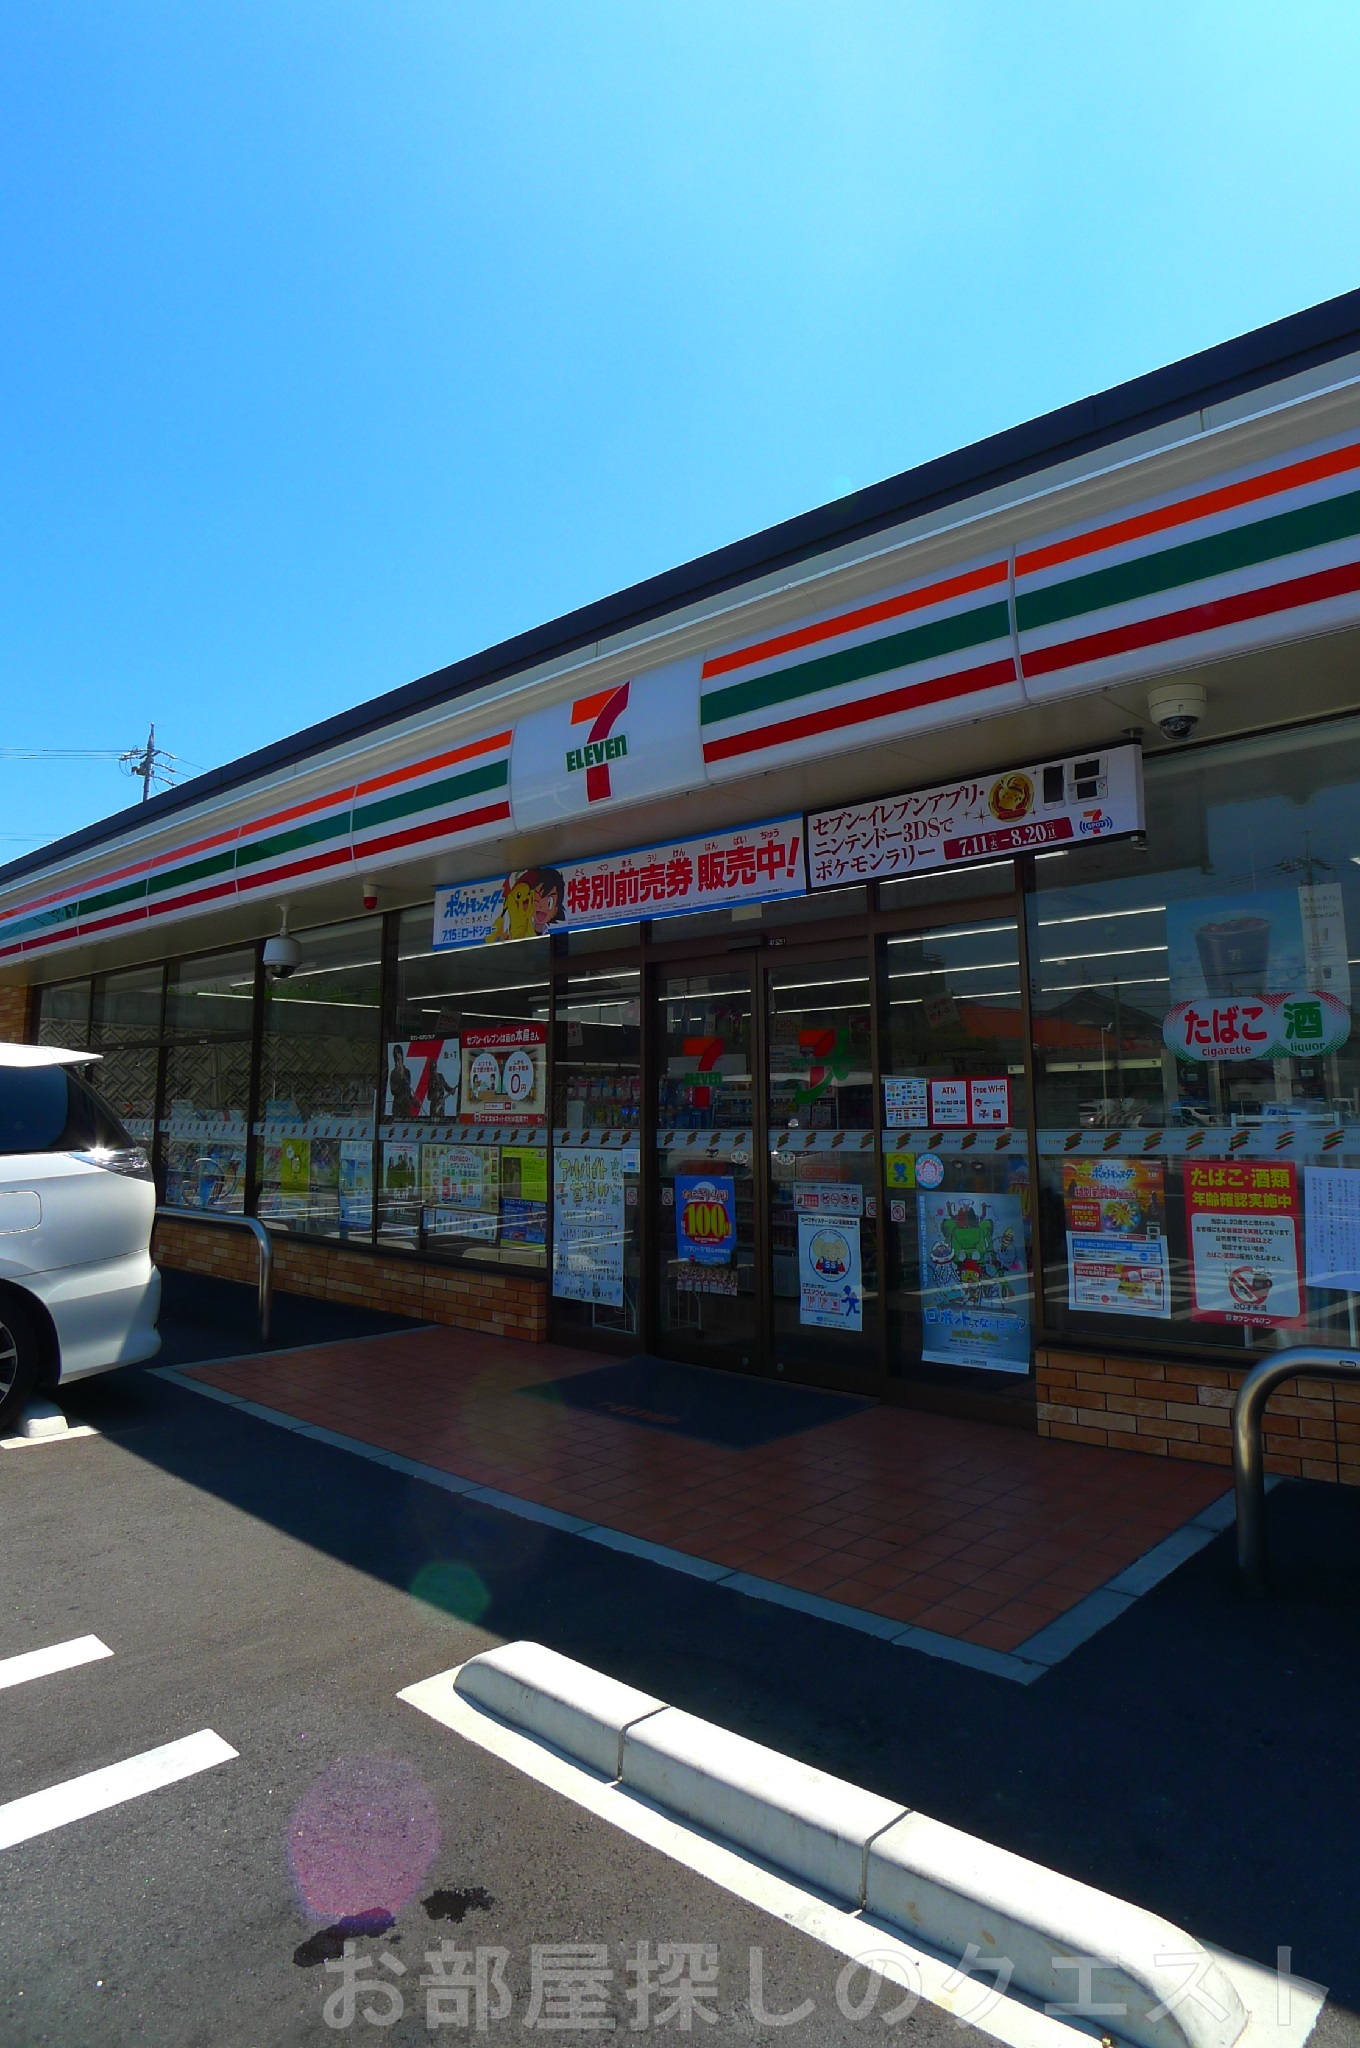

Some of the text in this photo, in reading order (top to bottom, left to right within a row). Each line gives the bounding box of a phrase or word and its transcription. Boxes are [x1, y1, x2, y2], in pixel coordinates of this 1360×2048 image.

[570, 681, 630, 802] 7
[814, 817, 955, 858] ニンテンドー3DSで
[815, 847, 936, 881] ポケモンラリー
[567, 857, 694, 914] 特別前売券
[443, 889, 505, 918] ポケットモンスター
[1184, 1004, 1268, 1046] たばこ
[1283, 1000, 1324, 1040] 酒
[1201, 1045, 1252, 1058] cigarette
[1290, 1041, 1326, 1053] liquor
[511, 1074, 527, 1094] 0円
[941, 1086, 957, 1094] ATM
[973, 1086, 987, 1094] Free
[1190, 1167, 1291, 1189] たばこ・酒類
[1191, 1191, 1292, 1209] 年齢確認実施中
